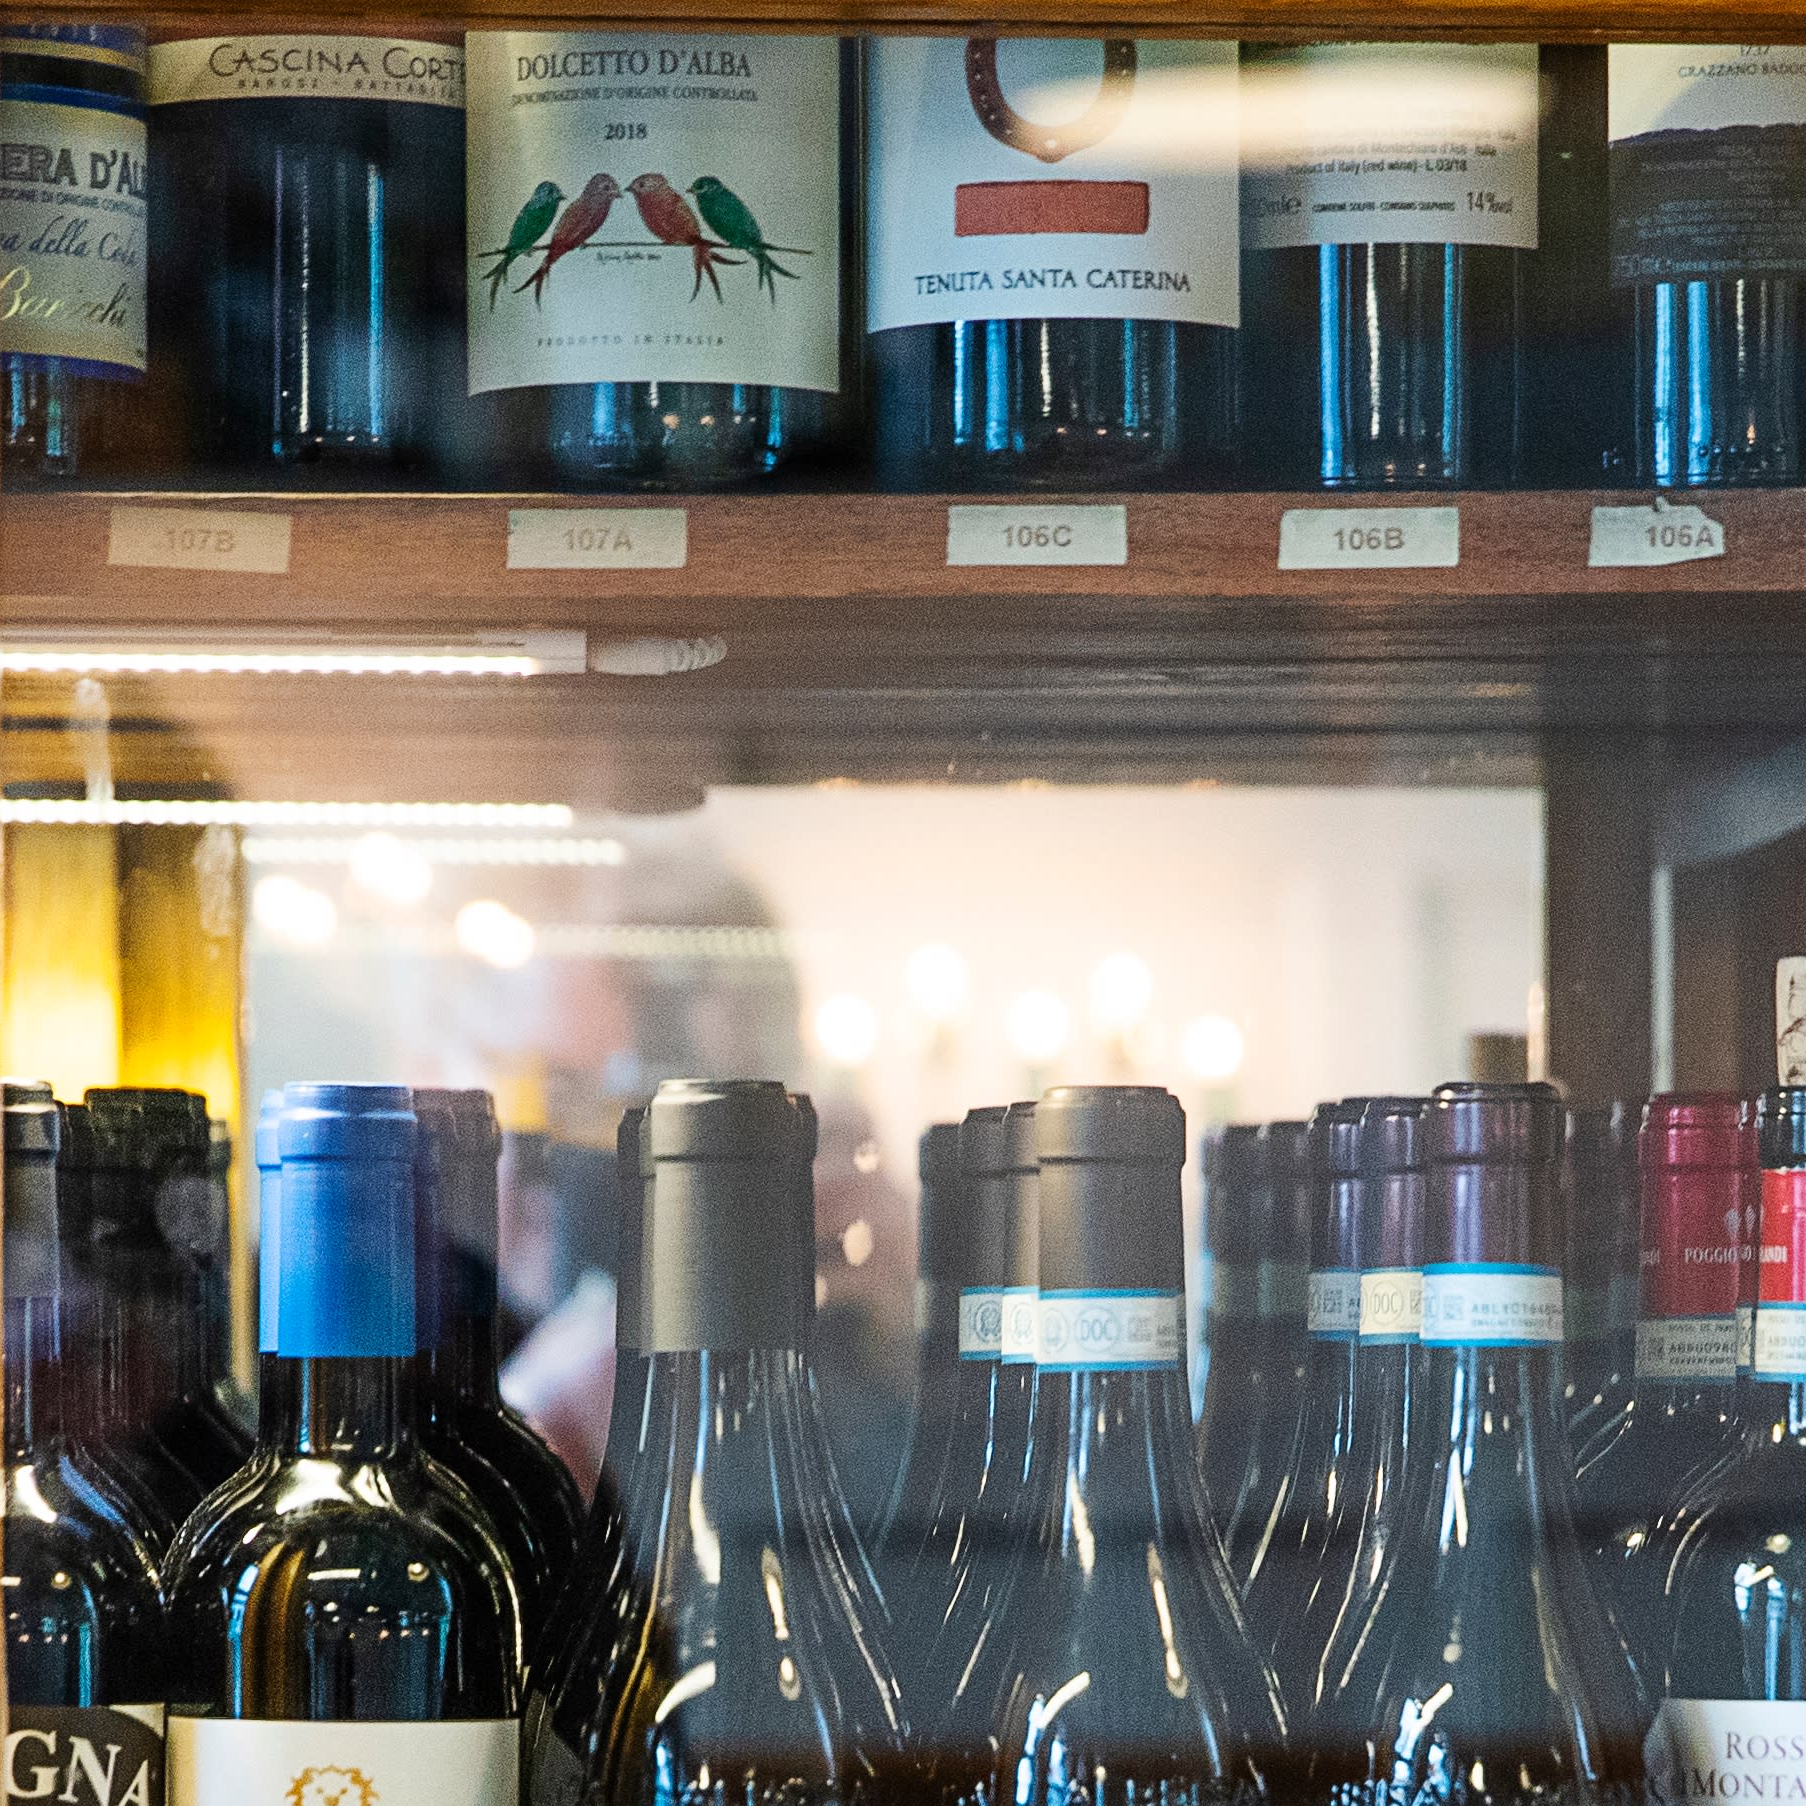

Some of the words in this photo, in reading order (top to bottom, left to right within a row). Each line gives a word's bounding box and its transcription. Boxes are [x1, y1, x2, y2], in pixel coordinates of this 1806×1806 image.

[208, 44, 370, 78] CASCINA
[517, 49, 650, 82] DOLCETTO
[657, 49, 752, 78] D'ALBA
[603, 123, 648, 141] 2018
[915, 270, 994, 297] TENUTA
[1001, 267, 1078, 291] SANTA
[1086, 267, 1191, 294] CATERINA
[562, 527, 633, 552] 107A
[1002, 525, 1073, 549] 106C
[1333, 528, 1405, 551] 106B
[1644, 525, 1715, 549] 106A
[1372, 1291, 1400, 1315] DOC
